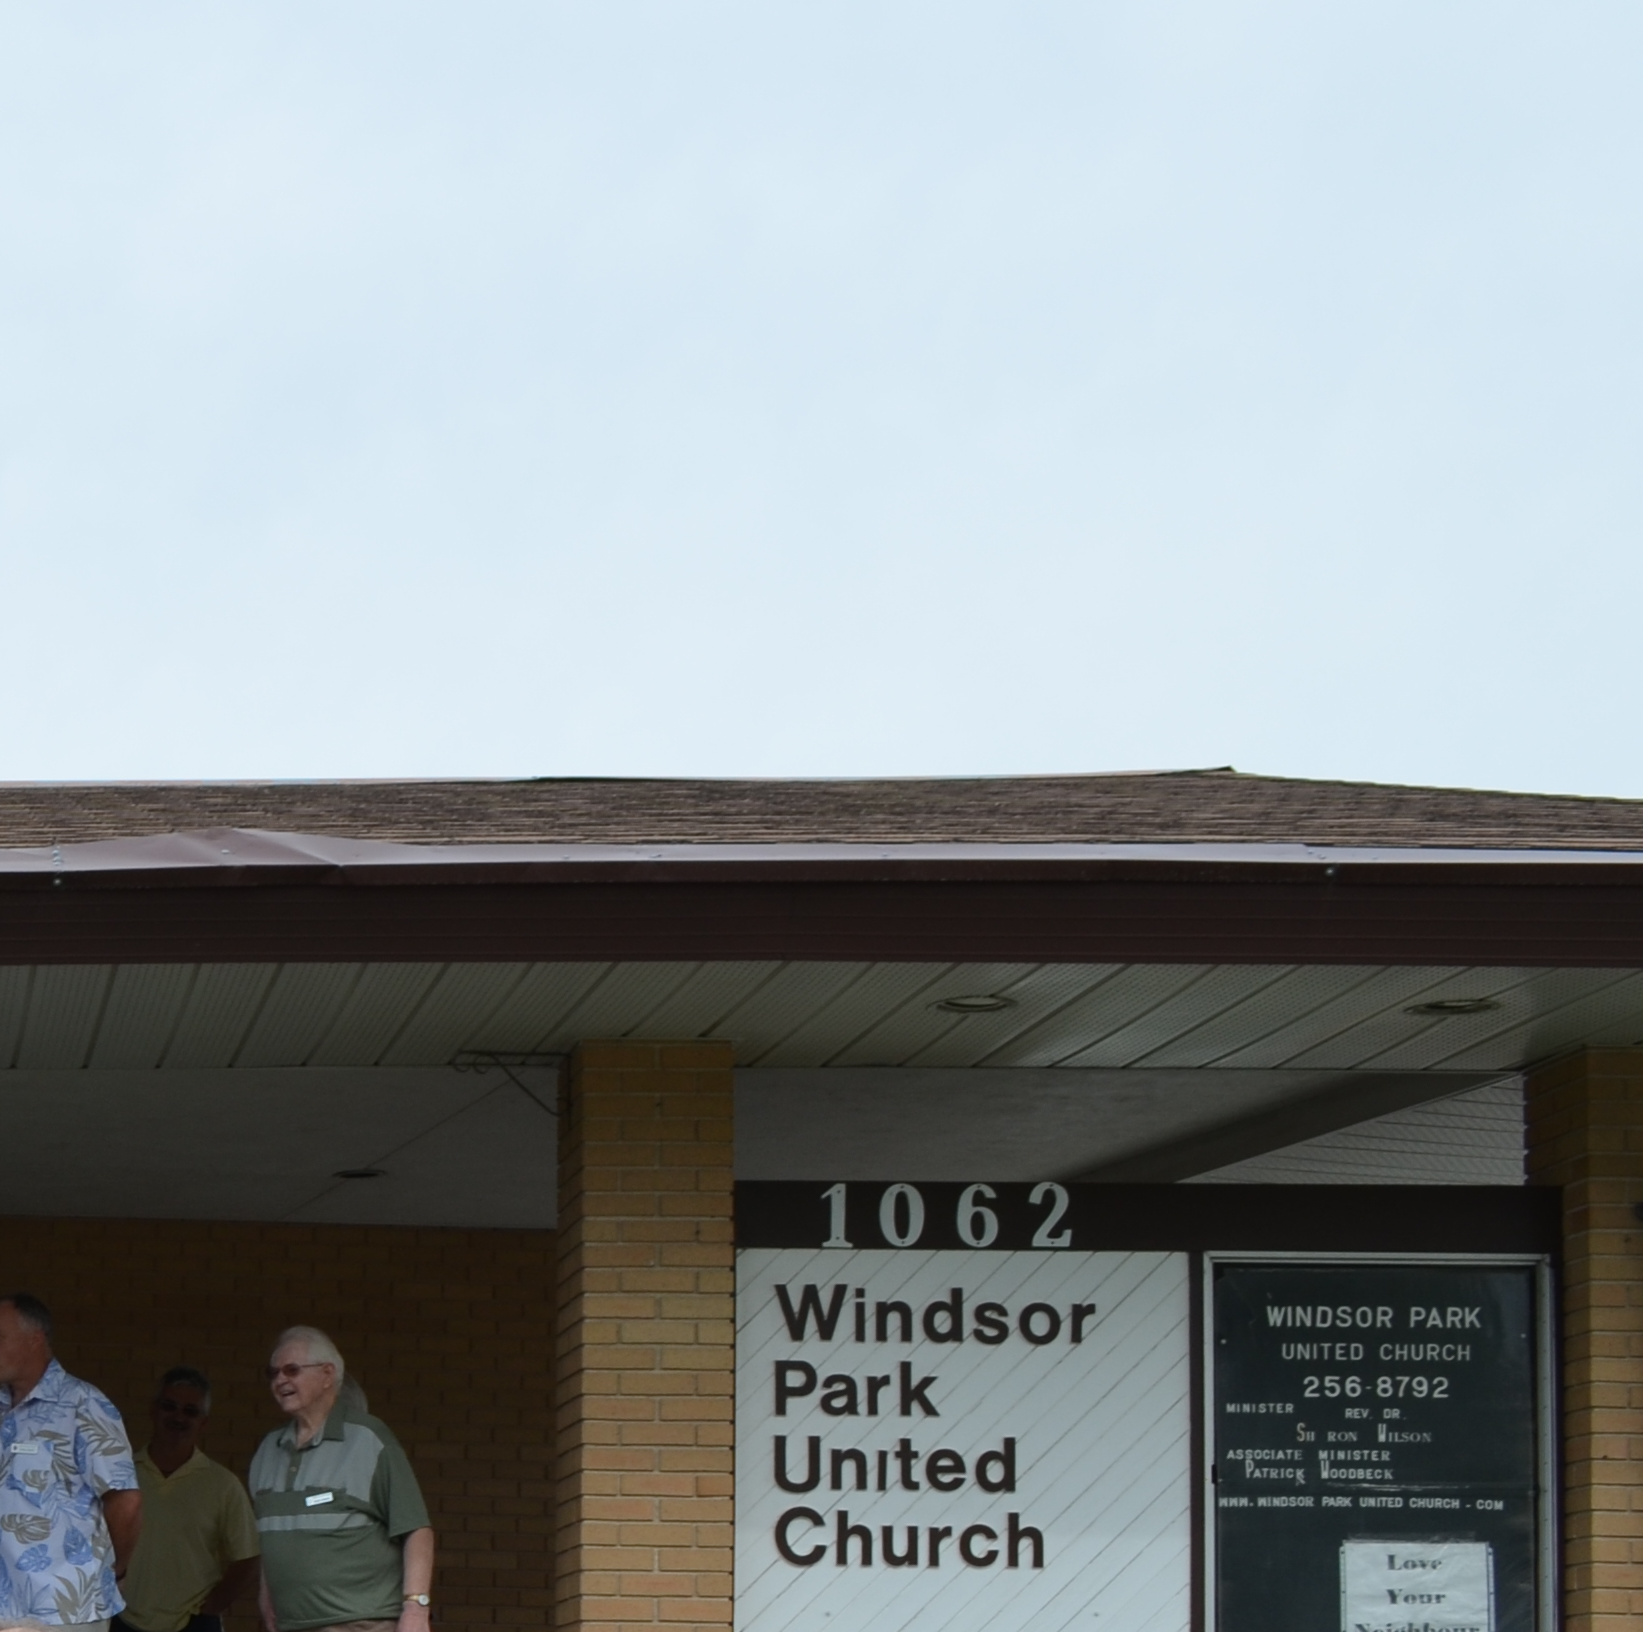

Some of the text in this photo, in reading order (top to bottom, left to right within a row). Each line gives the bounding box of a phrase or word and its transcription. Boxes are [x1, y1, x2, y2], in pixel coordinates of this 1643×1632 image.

[820, 1182, 1072, 1248] 1062
[774, 1284, 1096, 1345] Windsor
[1267, 1306, 1482, 1328] WINDSOR PARK
[1282, 1343, 1471, 1361] UNITED CHURCH
[774, 1360, 940, 1416] Park
[1303, 1376, 1449, 1398] 256-8792
[1226, 1403, 1294, 1413] MINISTER
[773, 1435, 1016, 1493] United
[1226, 1449, 1391, 1460] ASSOCIATE MINISTER
[1321, 1496, 1352, 1507] PARK
[1359, 1497, 1403, 1508] UNITED
[1409, 1497, 1460, 1509] CHURCH
[774, 1506, 1044, 1568] Church
[1386, 1554, 1442, 1571] Love
[1386, 1589, 1446, 1605] Your
